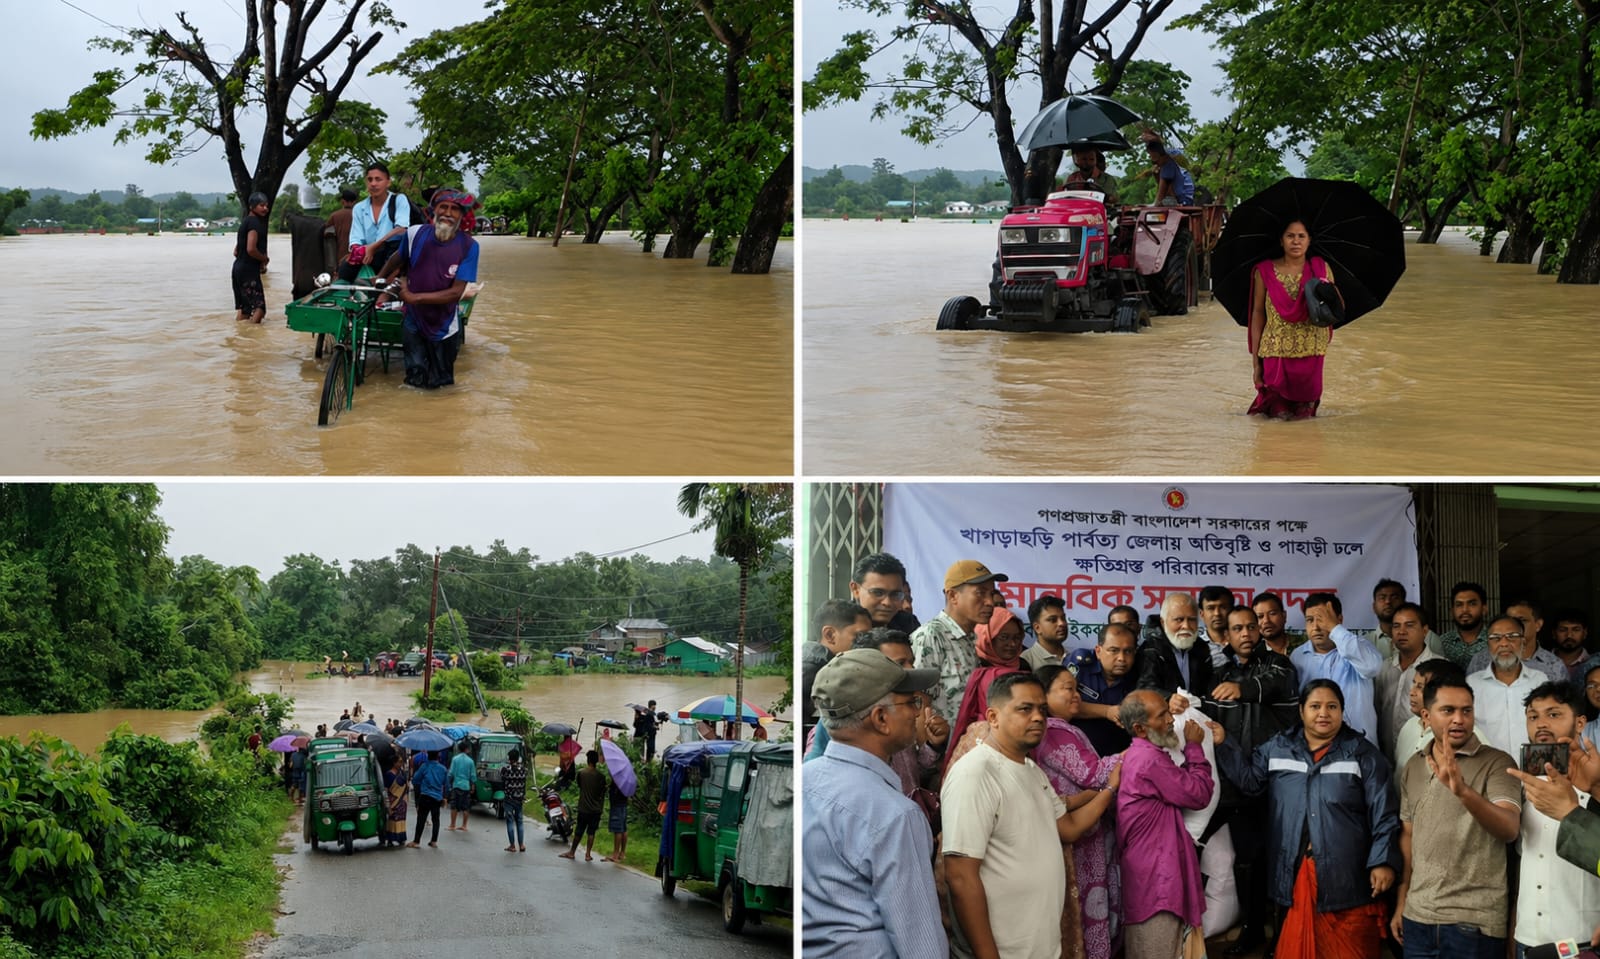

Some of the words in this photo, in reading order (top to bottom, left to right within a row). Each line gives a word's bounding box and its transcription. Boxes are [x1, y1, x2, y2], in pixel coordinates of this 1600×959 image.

[1132, 514, 1202, 528] বাংলাদেশ
[1206, 517, 1271, 531] সরকারের
[1276, 519, 1308, 532] পক্ষে
[960, 527, 1055, 550] খাগড়াছড়ি
[1061, 528, 1120, 550] পার্বত্য
[1126, 535, 1182, 551] জেলায়
[1188, 533, 1252, 558] অতিবৃষ্টি
[1257, 540, 1271, 552] ও
[1278, 536, 1328, 557] পাহাড়ী
[1332, 541, 1364, 556] ঢলে
[1151, 556, 1229, 576] পরিবারের
[1234, 561, 1275, 577] মাঝে
